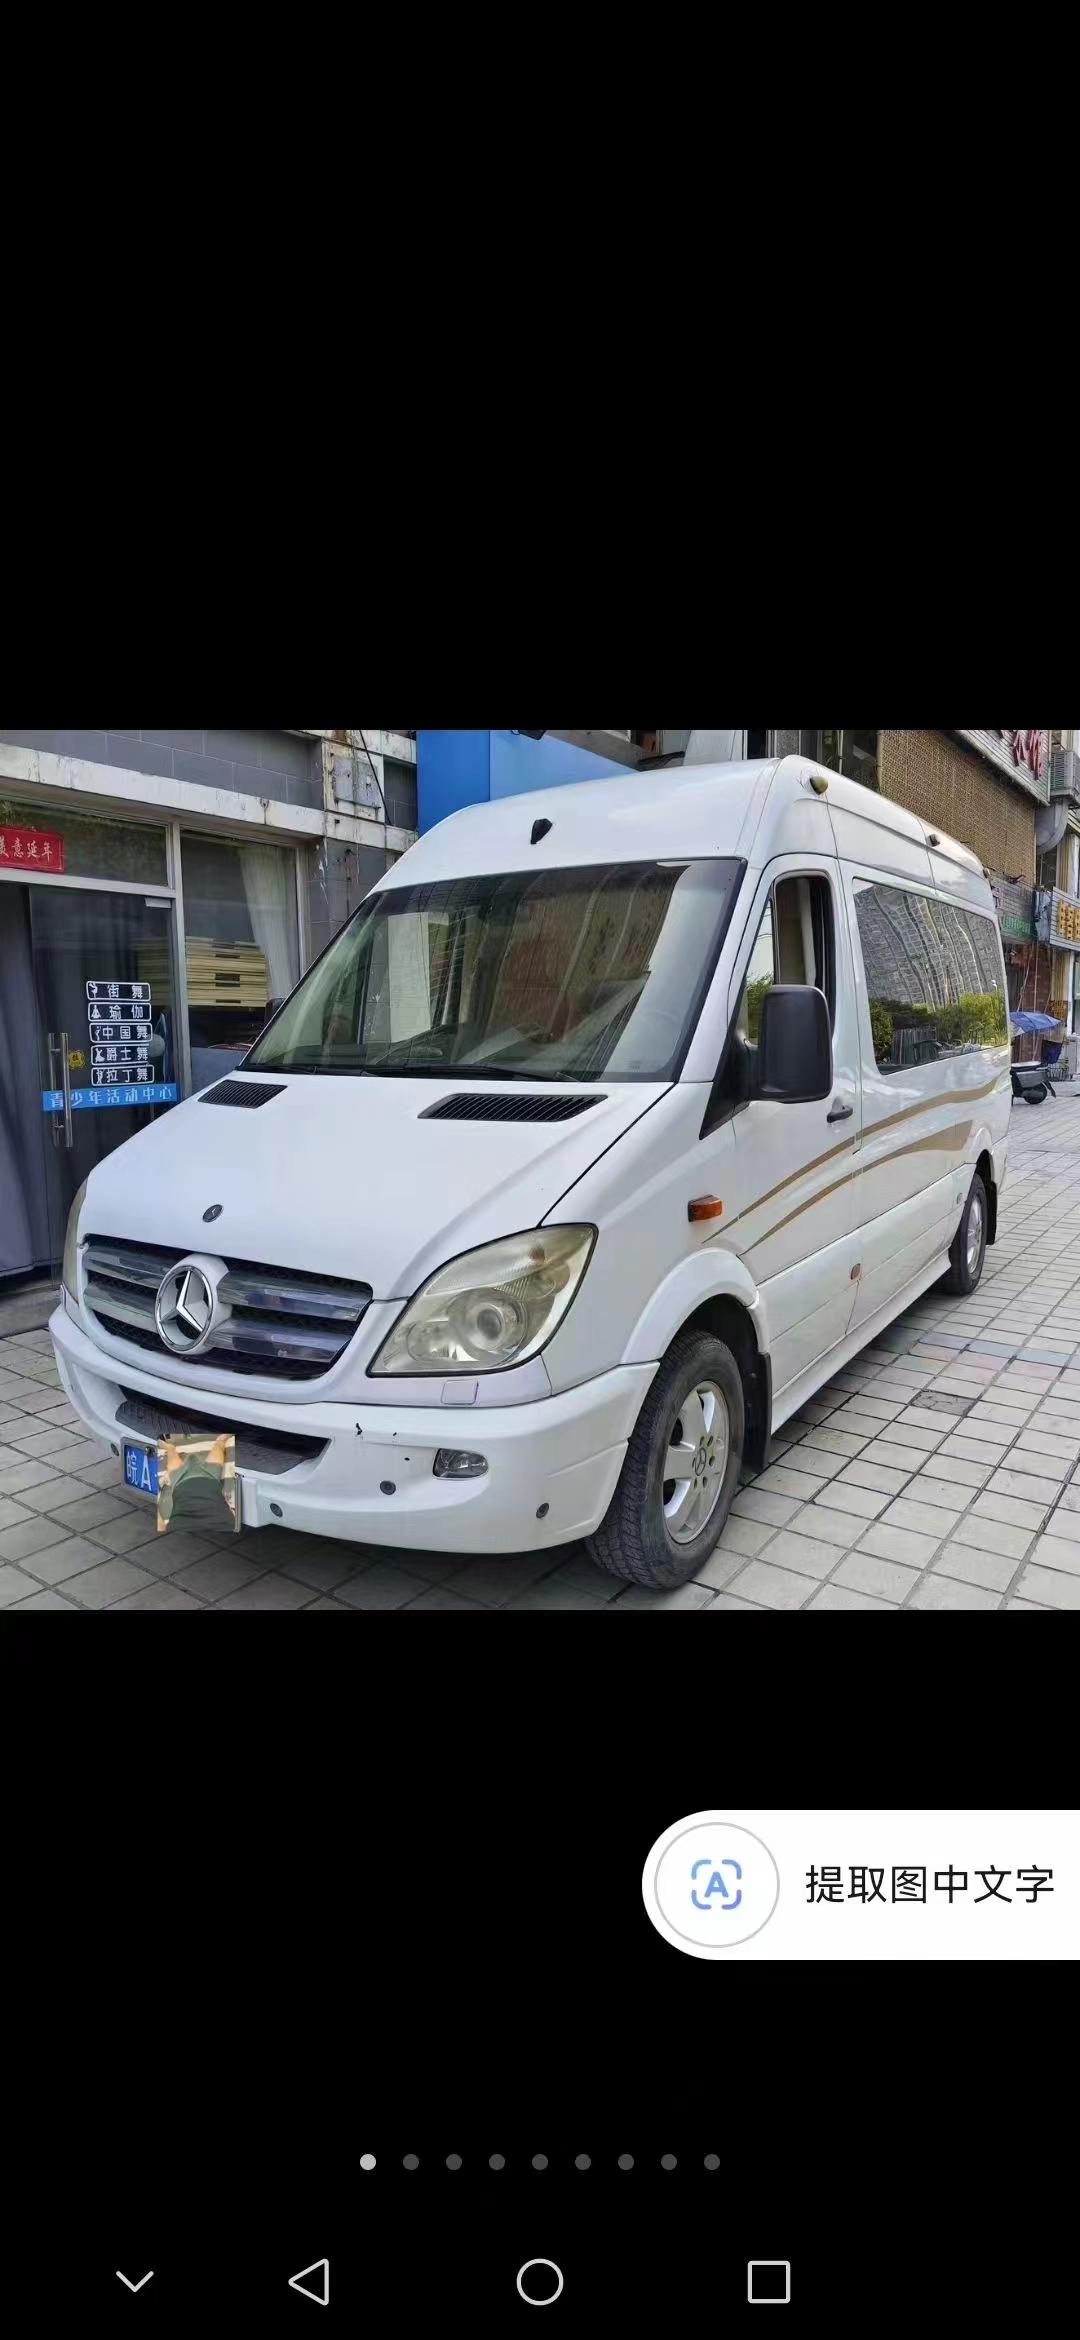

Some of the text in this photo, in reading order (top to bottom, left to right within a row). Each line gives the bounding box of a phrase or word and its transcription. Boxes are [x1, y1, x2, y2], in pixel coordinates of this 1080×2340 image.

[107, 984, 144, 999] 街舞
[109, 1004, 144, 1020] 瑜伽
[102, 1025, 149, 1040] 中国舞
[106, 1047, 149, 1062] 爵士舞
[106, 1067, 149, 1083] 拉丁舞
[51, 1087, 172, 1108] 青少年活动中心
